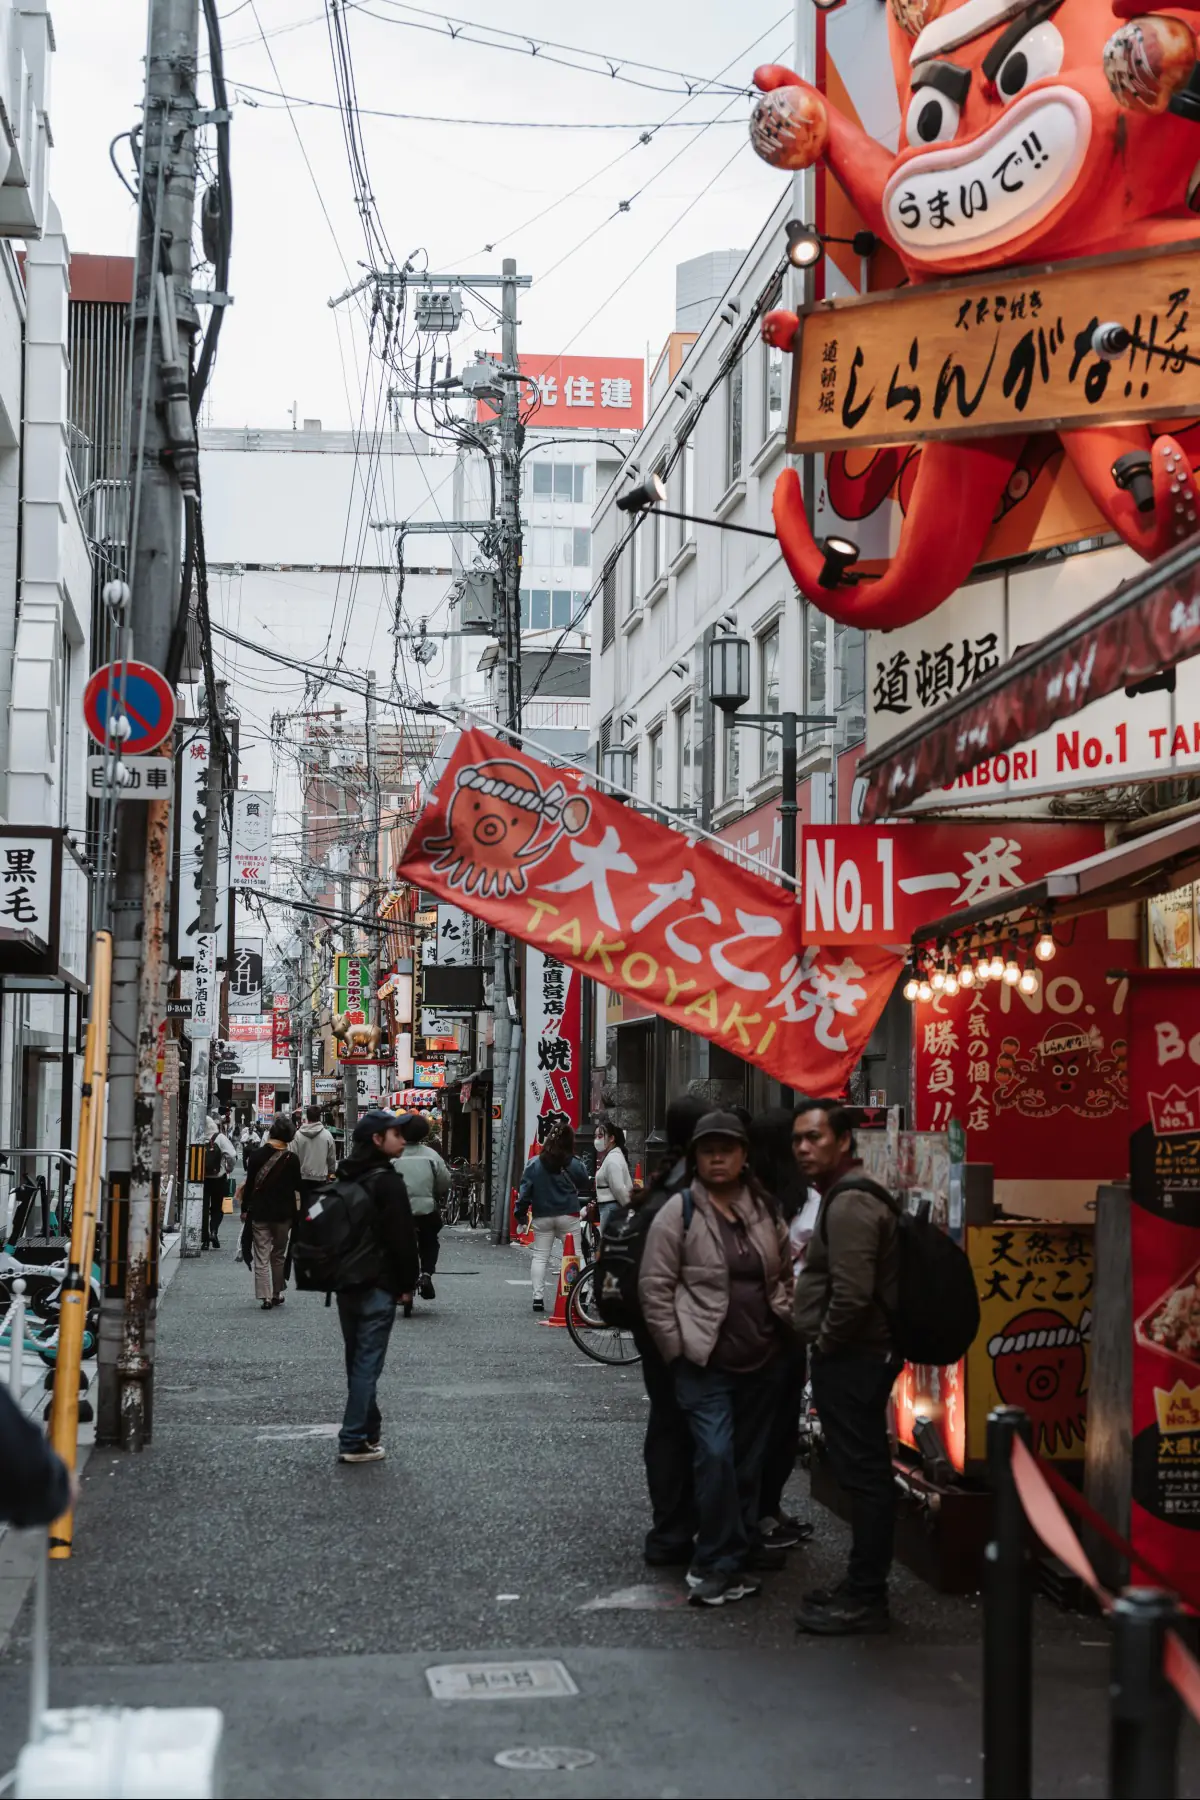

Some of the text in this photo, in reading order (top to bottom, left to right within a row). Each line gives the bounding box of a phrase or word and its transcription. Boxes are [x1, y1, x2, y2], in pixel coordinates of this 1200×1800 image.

[899, 131, 1049, 229] うまいで!!
[517, 375, 632, 408] 光住建
[818, 340, 838, 414] 道頓堀
[942, 749, 1037, 791] NBORI
[1056, 722, 1128, 772] No.1
[1, 848, 37, 923] 黒毛
[805, 837, 894, 934] No.1
[527, 898, 777, 1055] TAKOYAKI
[966, 980, 990, 1131] 人気の個人店
[1160, 1112, 1194, 1128] No.1
